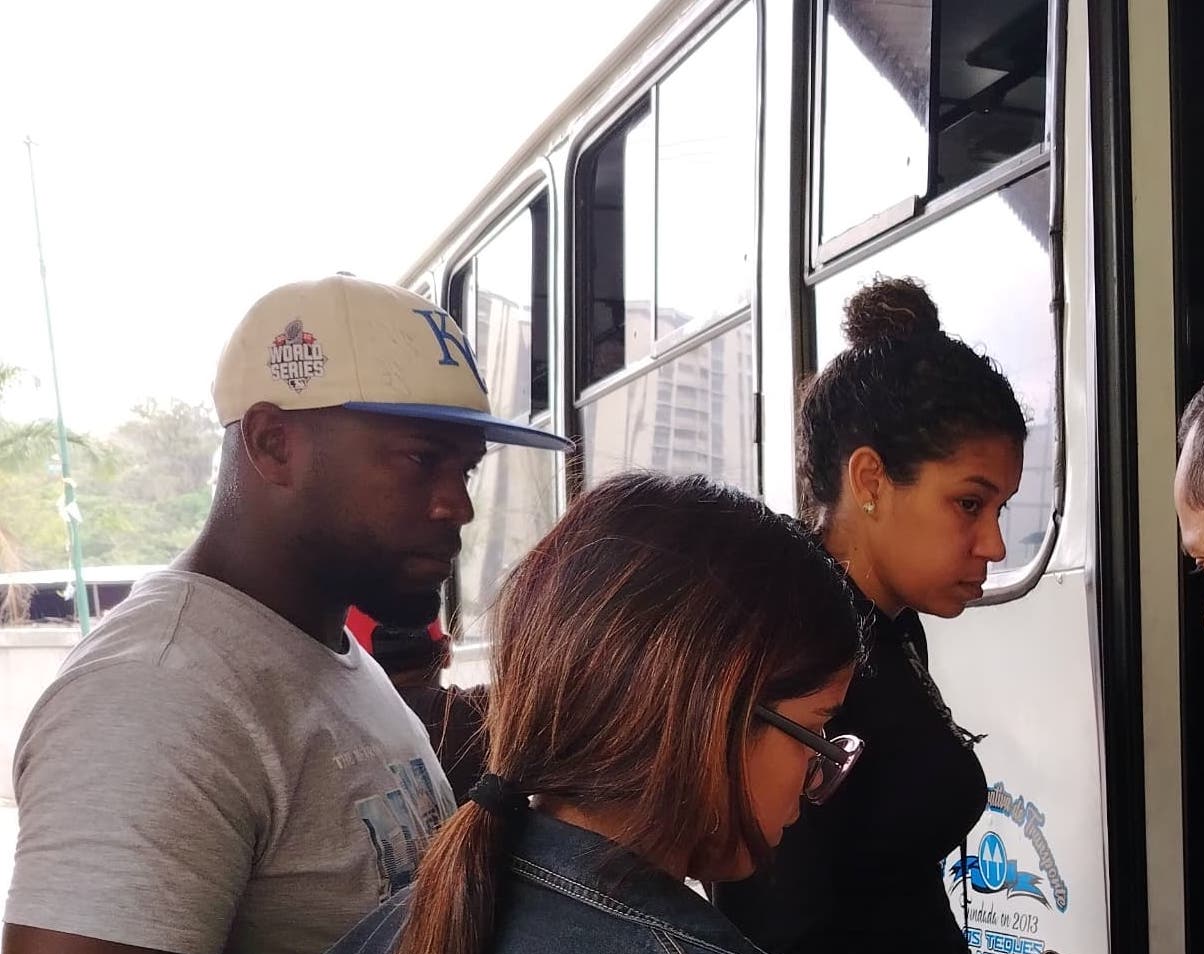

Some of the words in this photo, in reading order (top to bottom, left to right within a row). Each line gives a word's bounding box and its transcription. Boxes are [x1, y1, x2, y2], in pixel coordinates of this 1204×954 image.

[271, 343, 323, 364] WORLD
[271, 360, 325, 380] SERIES
[961, 898, 997, 926] undada
[1000, 911, 1010, 928] en
[1012, 911, 1039, 934] 2013
